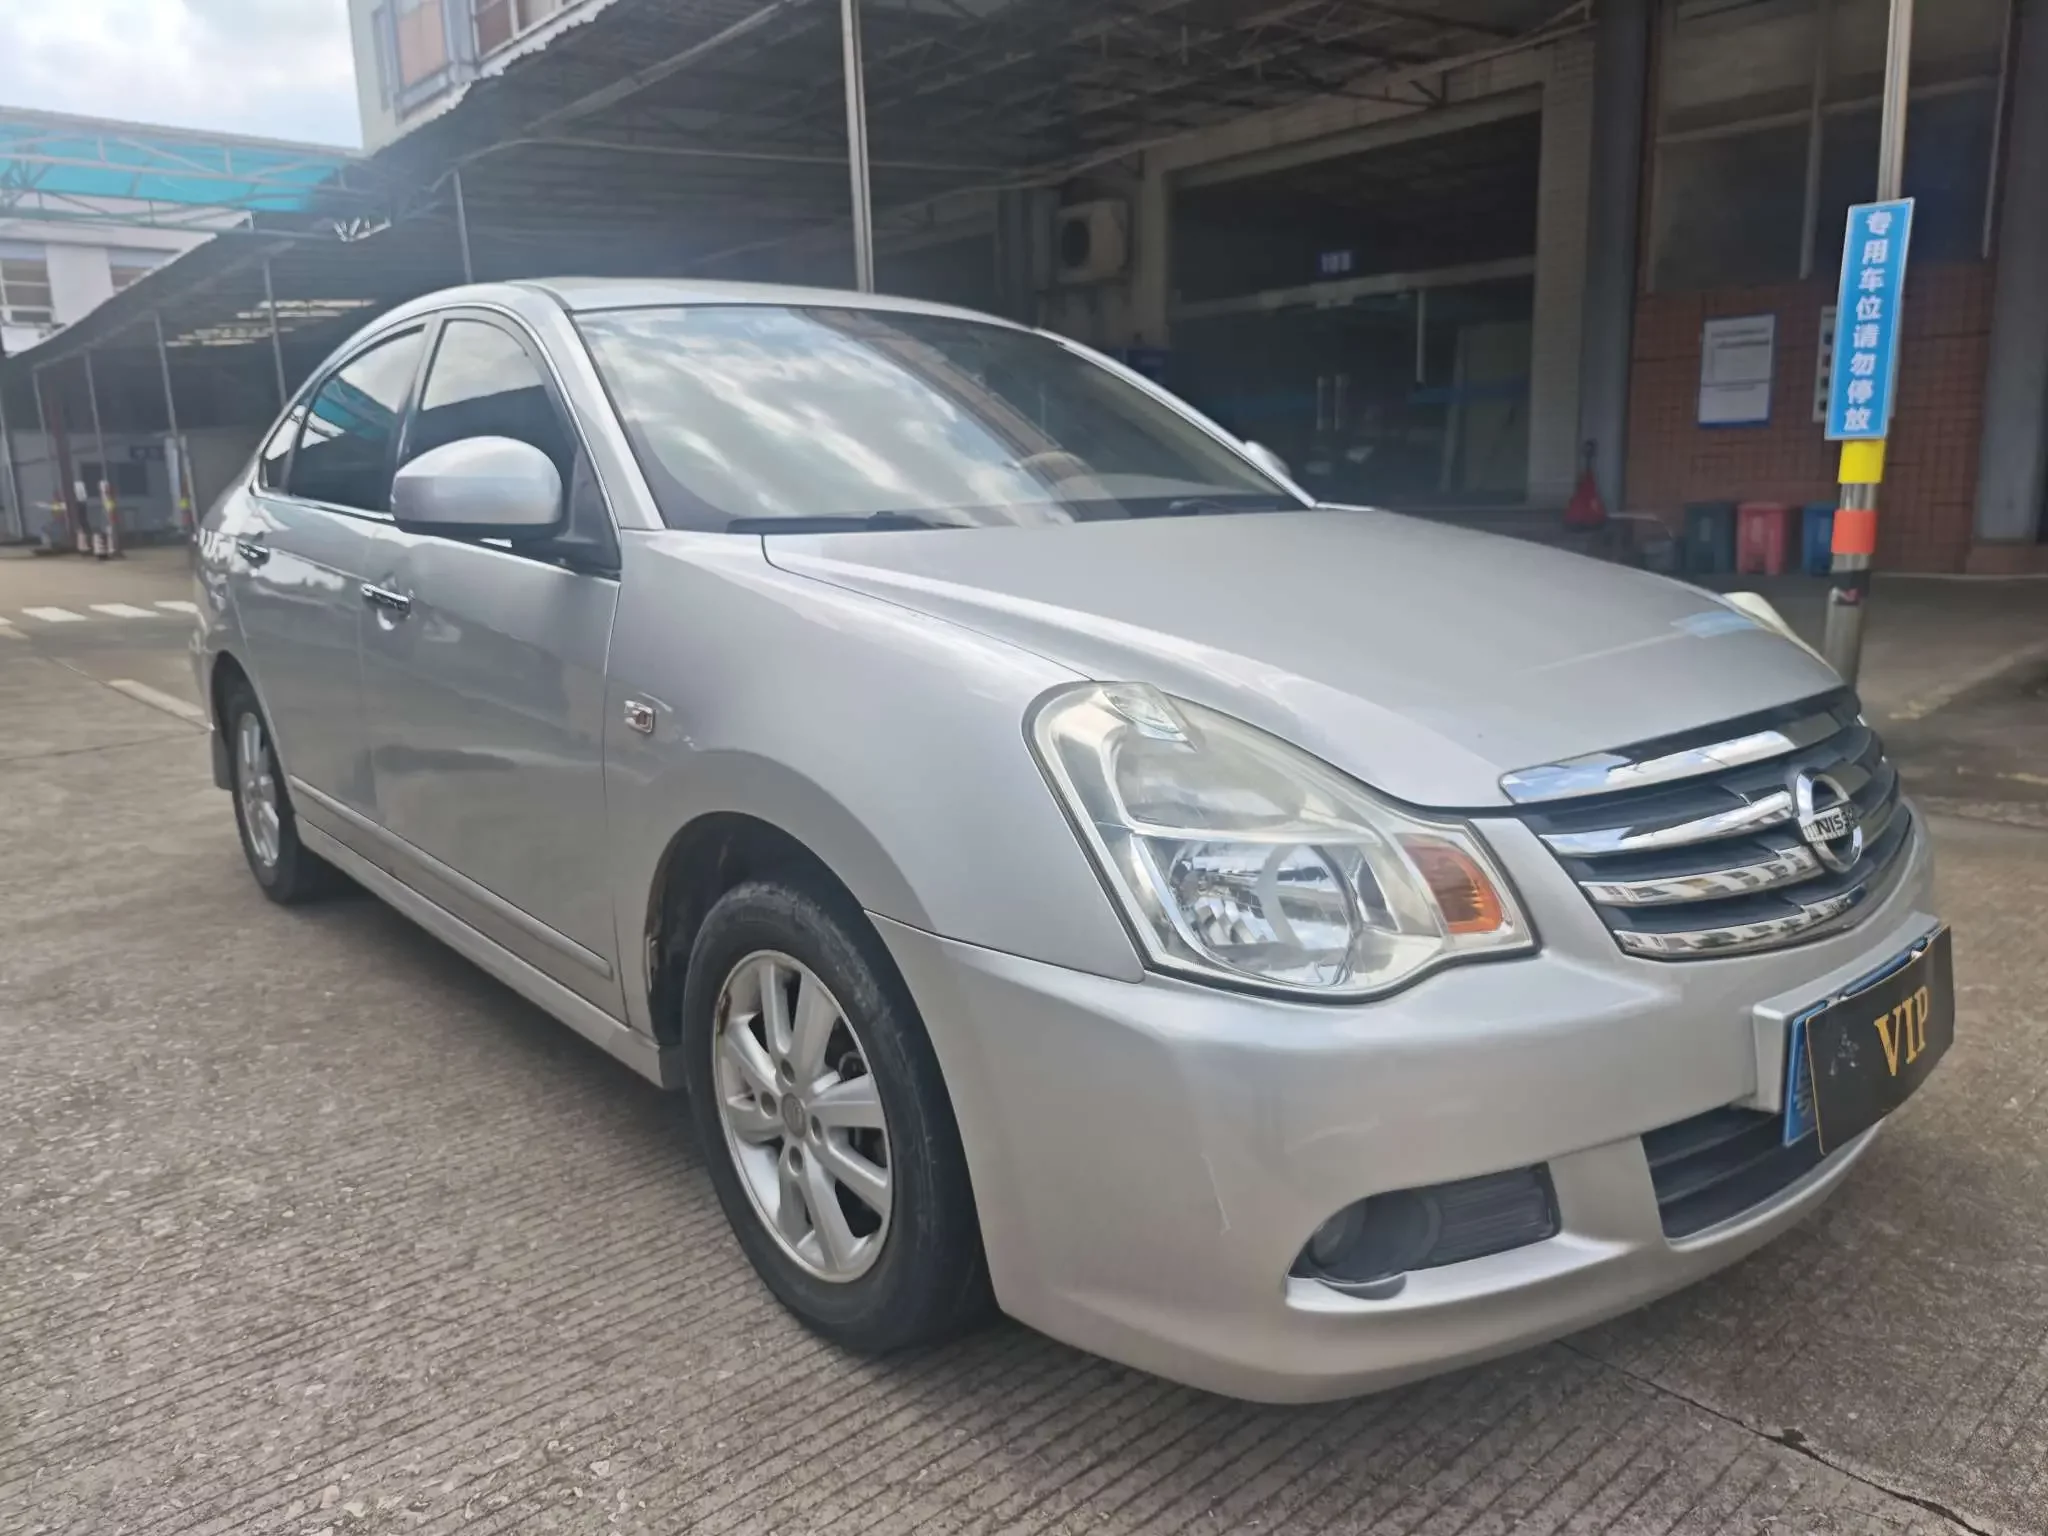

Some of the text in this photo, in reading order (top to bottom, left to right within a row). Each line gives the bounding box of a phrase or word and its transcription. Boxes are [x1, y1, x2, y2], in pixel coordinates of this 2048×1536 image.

[1844, 210, 1892, 431] 专用车位请勿停放
[1873, 984, 1929, 1077] VIP
